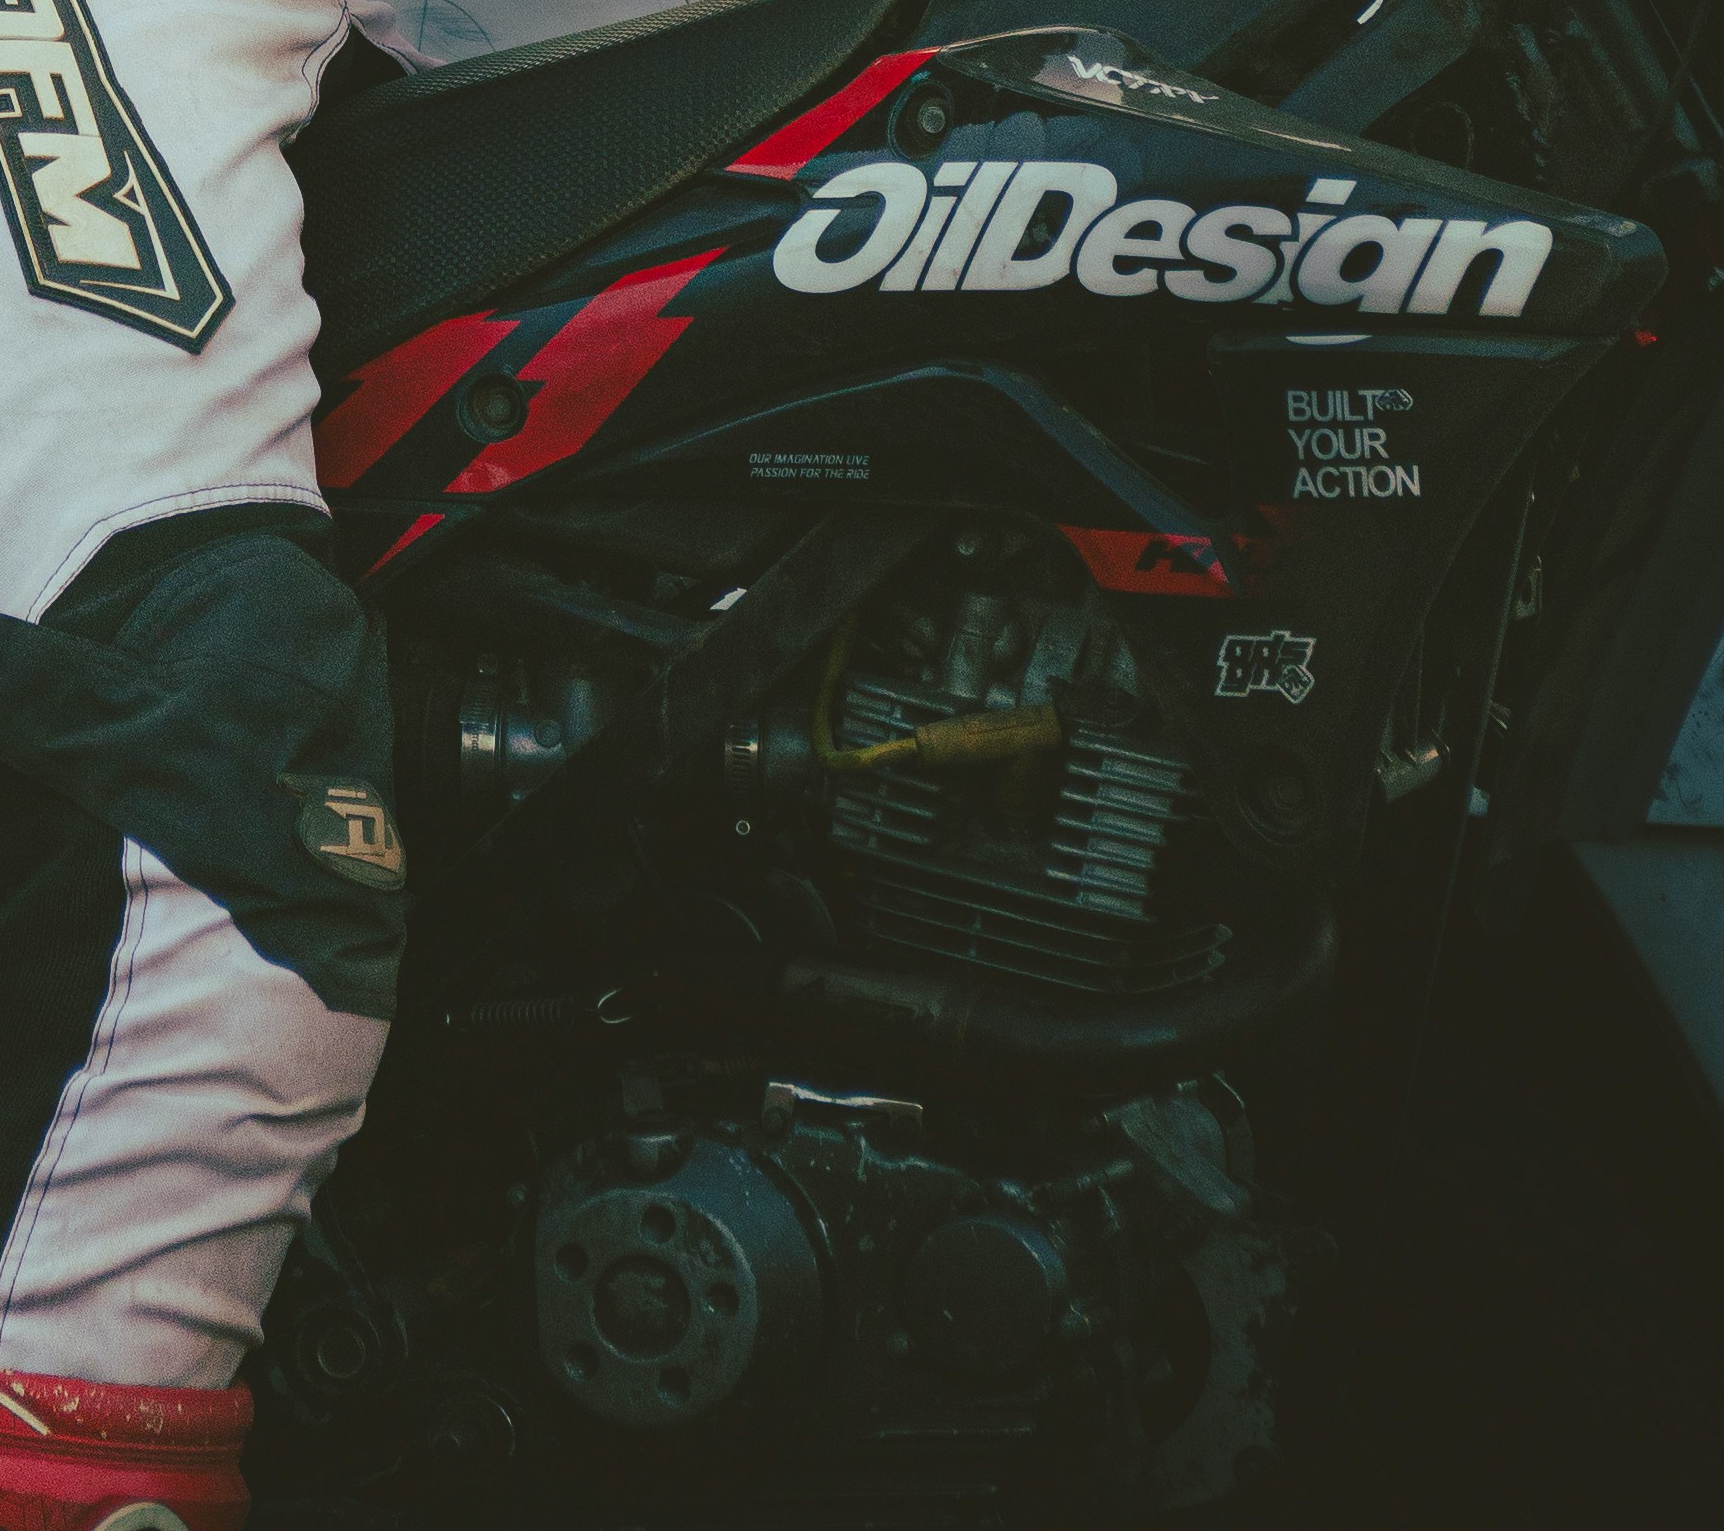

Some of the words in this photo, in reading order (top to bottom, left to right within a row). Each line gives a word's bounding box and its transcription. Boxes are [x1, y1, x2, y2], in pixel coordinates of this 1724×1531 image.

[1286, 389, 1385, 422] BUILT
[749, 453, 772, 464] OUR
[774, 453, 844, 465] IMAGINATION
[846, 455, 870, 466] LIVE
[1287, 427, 1389, 460] YOUR
[750, 467, 797, 478] PASSION
[799, 468, 822, 479] FOR
[825, 468, 844, 479] THE
[846, 469, 871, 480] RIDE
[1293, 465, 1421, 499] ACTION
